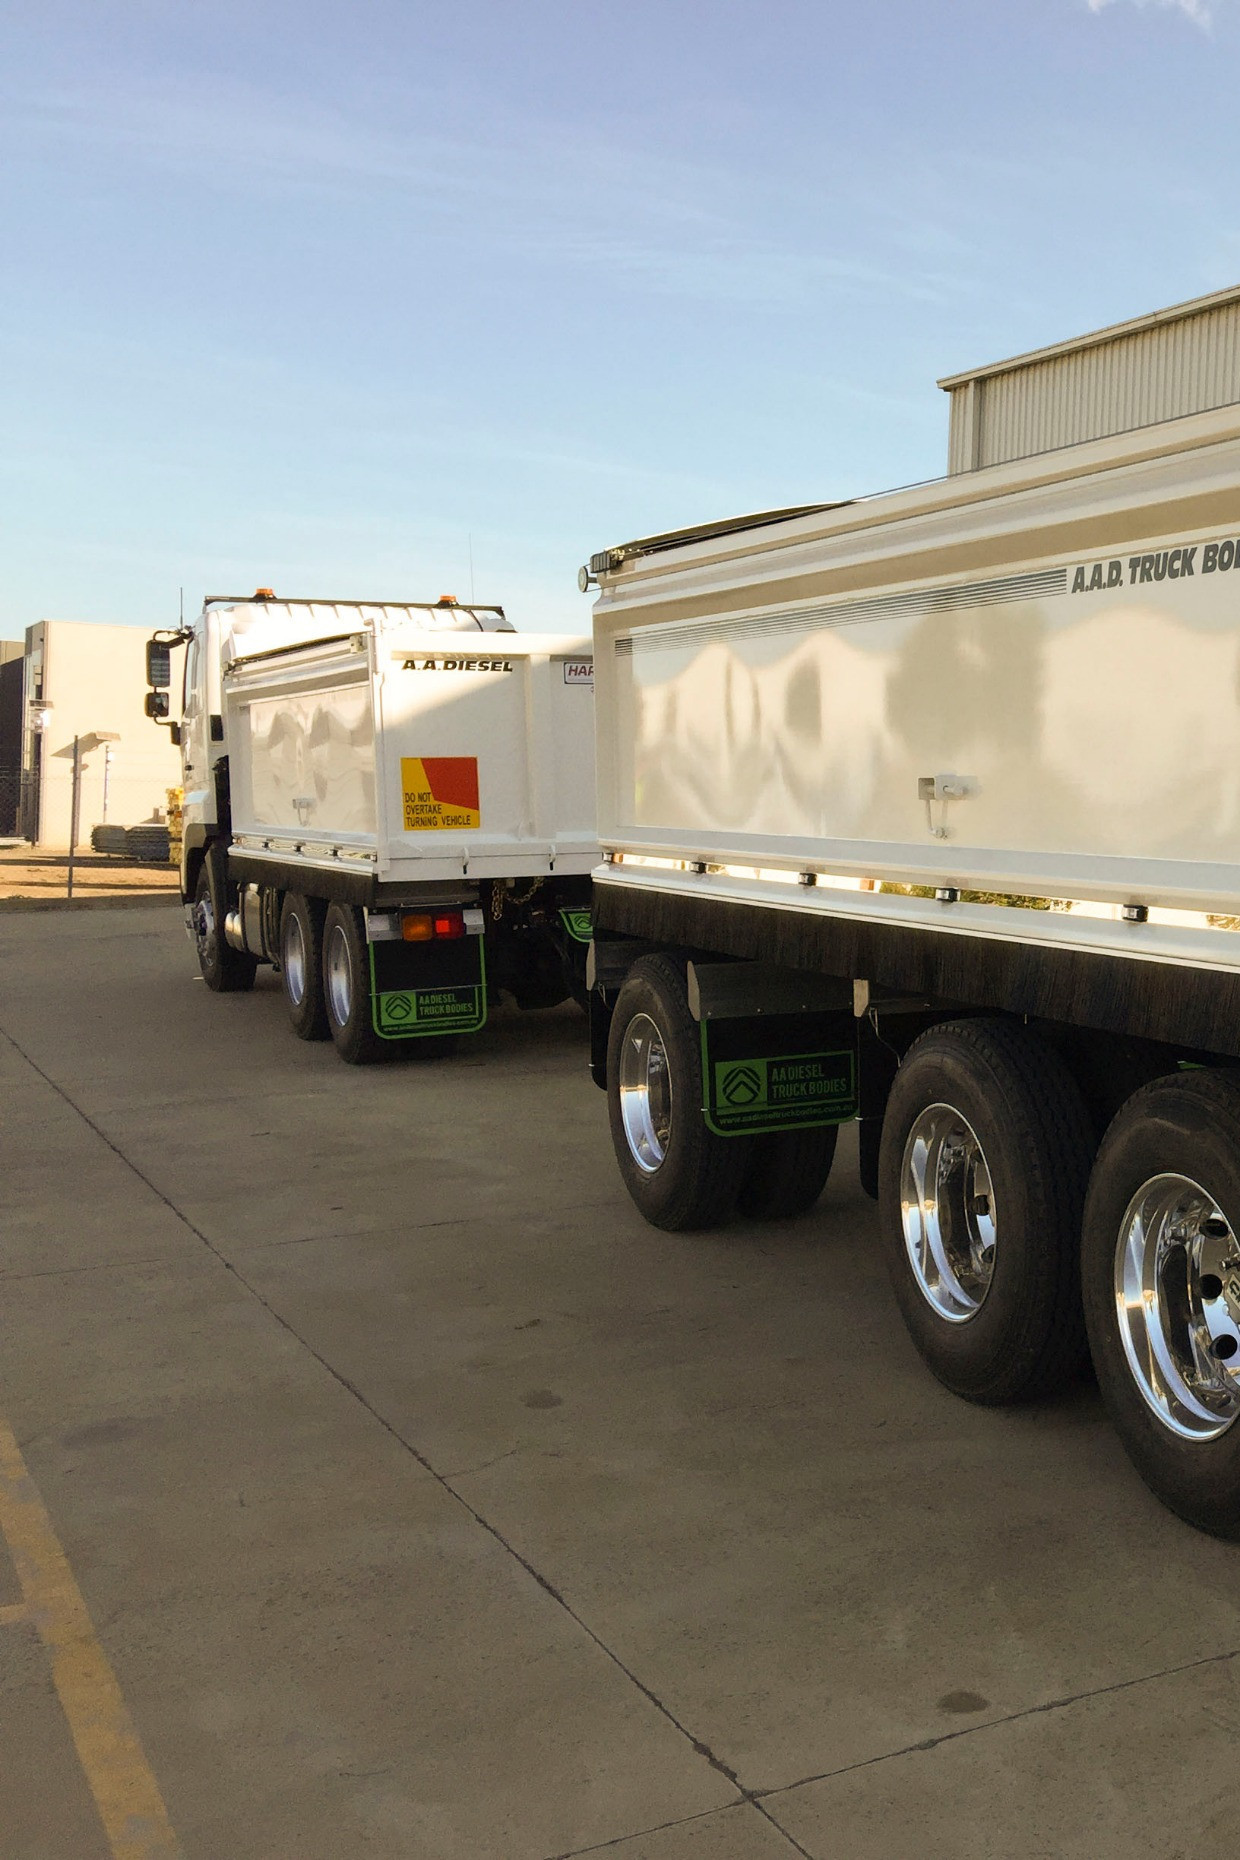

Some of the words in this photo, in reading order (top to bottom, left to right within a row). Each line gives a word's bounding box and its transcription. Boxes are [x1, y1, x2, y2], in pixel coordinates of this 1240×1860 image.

[1071, 560, 1124, 593] A.A.D.
[1129, 546, 1197, 585] TRUCK
[402, 660, 513, 672] A.A.DIESEL
[405, 792, 416, 802] DO
[418, 792, 431, 802] NOT
[405, 804, 442, 815] OVERTAKE
[406, 816, 438, 827] TURNING
[441, 815, 471, 825] VEHICLE
[431, 993, 456, 1003] DIESEL
[420, 1005, 445, 1015] TRUCK
[446, 1003, 473, 1013] BODIES
[788, 1064, 825, 1080] DIESEL
[772, 1082, 808, 1098] TRUCK
[809, 1078, 847, 1095] BODIES
